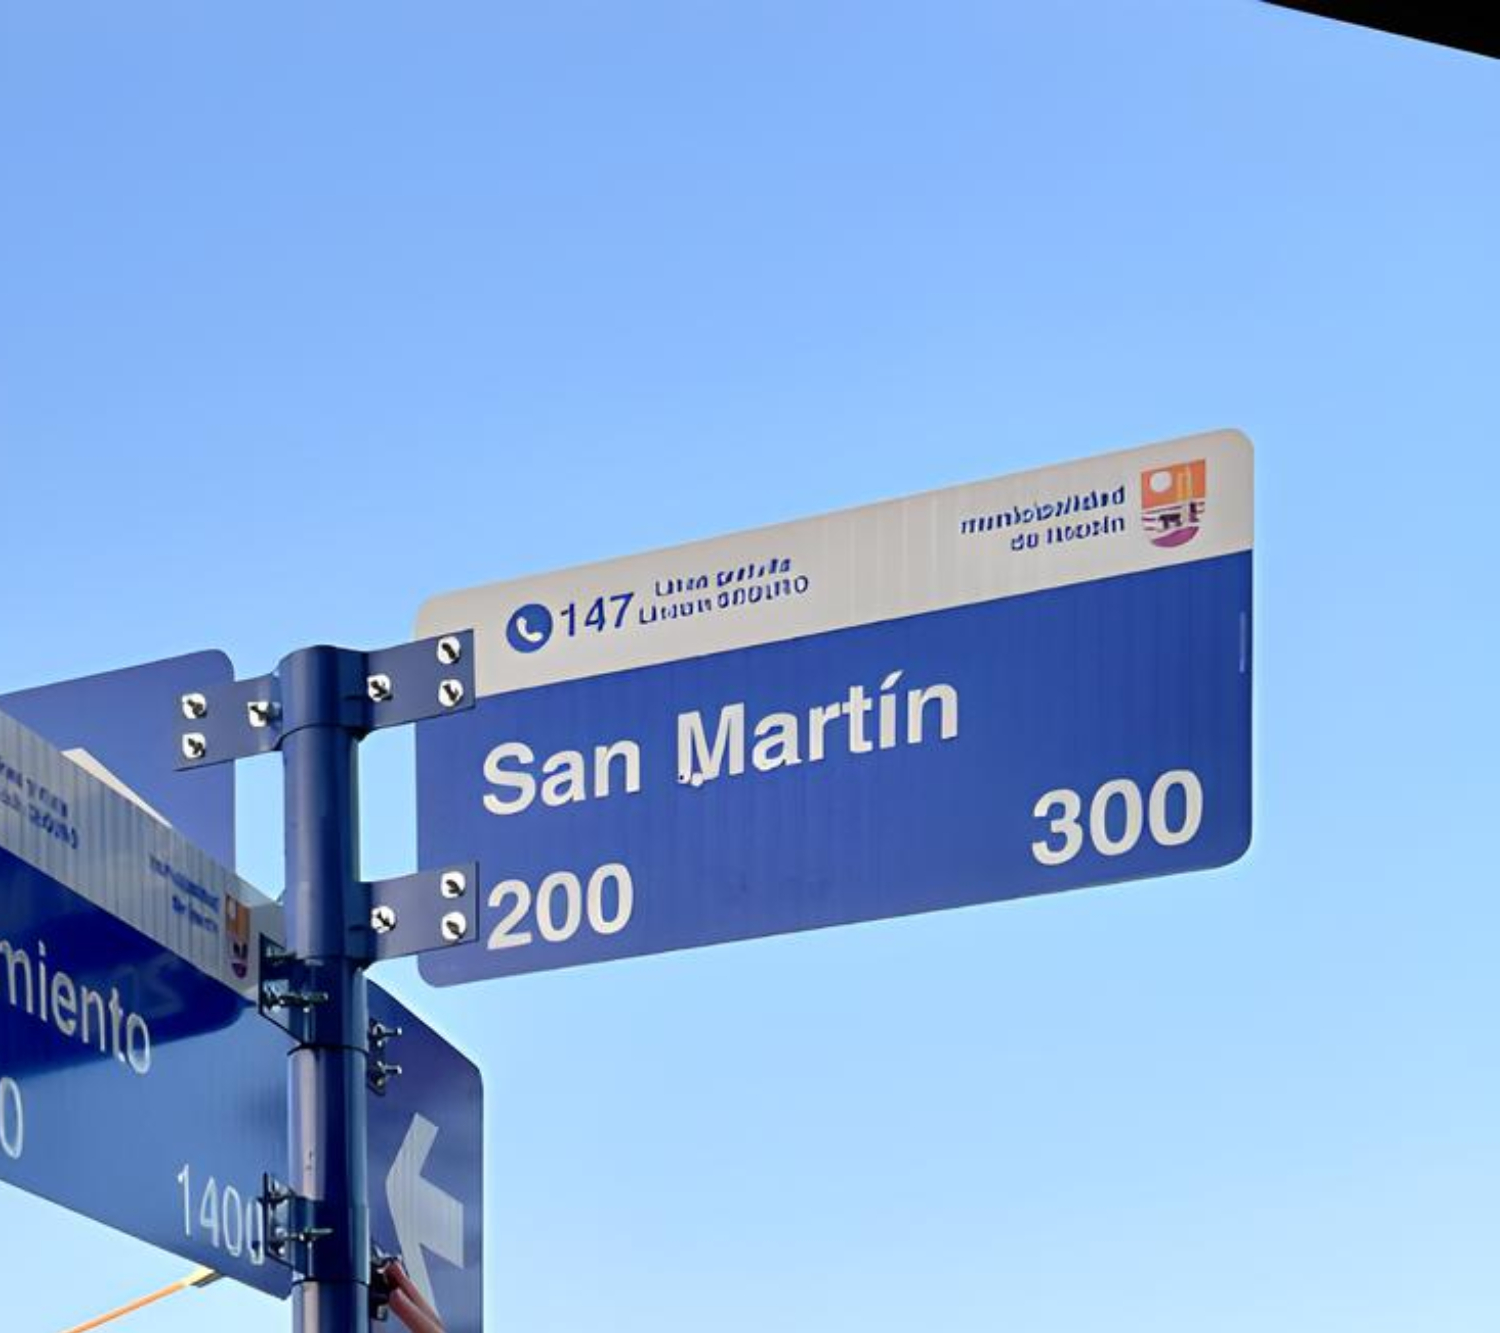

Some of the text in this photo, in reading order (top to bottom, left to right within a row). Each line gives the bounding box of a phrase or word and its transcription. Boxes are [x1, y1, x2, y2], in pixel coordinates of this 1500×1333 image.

[560, 591, 635, 637] 147
[481, 669, 959, 816] San Martín
[1031, 768, 1204, 867] 300
[486, 862, 635, 952] 200
[178, 1163, 264, 1266] 1400
